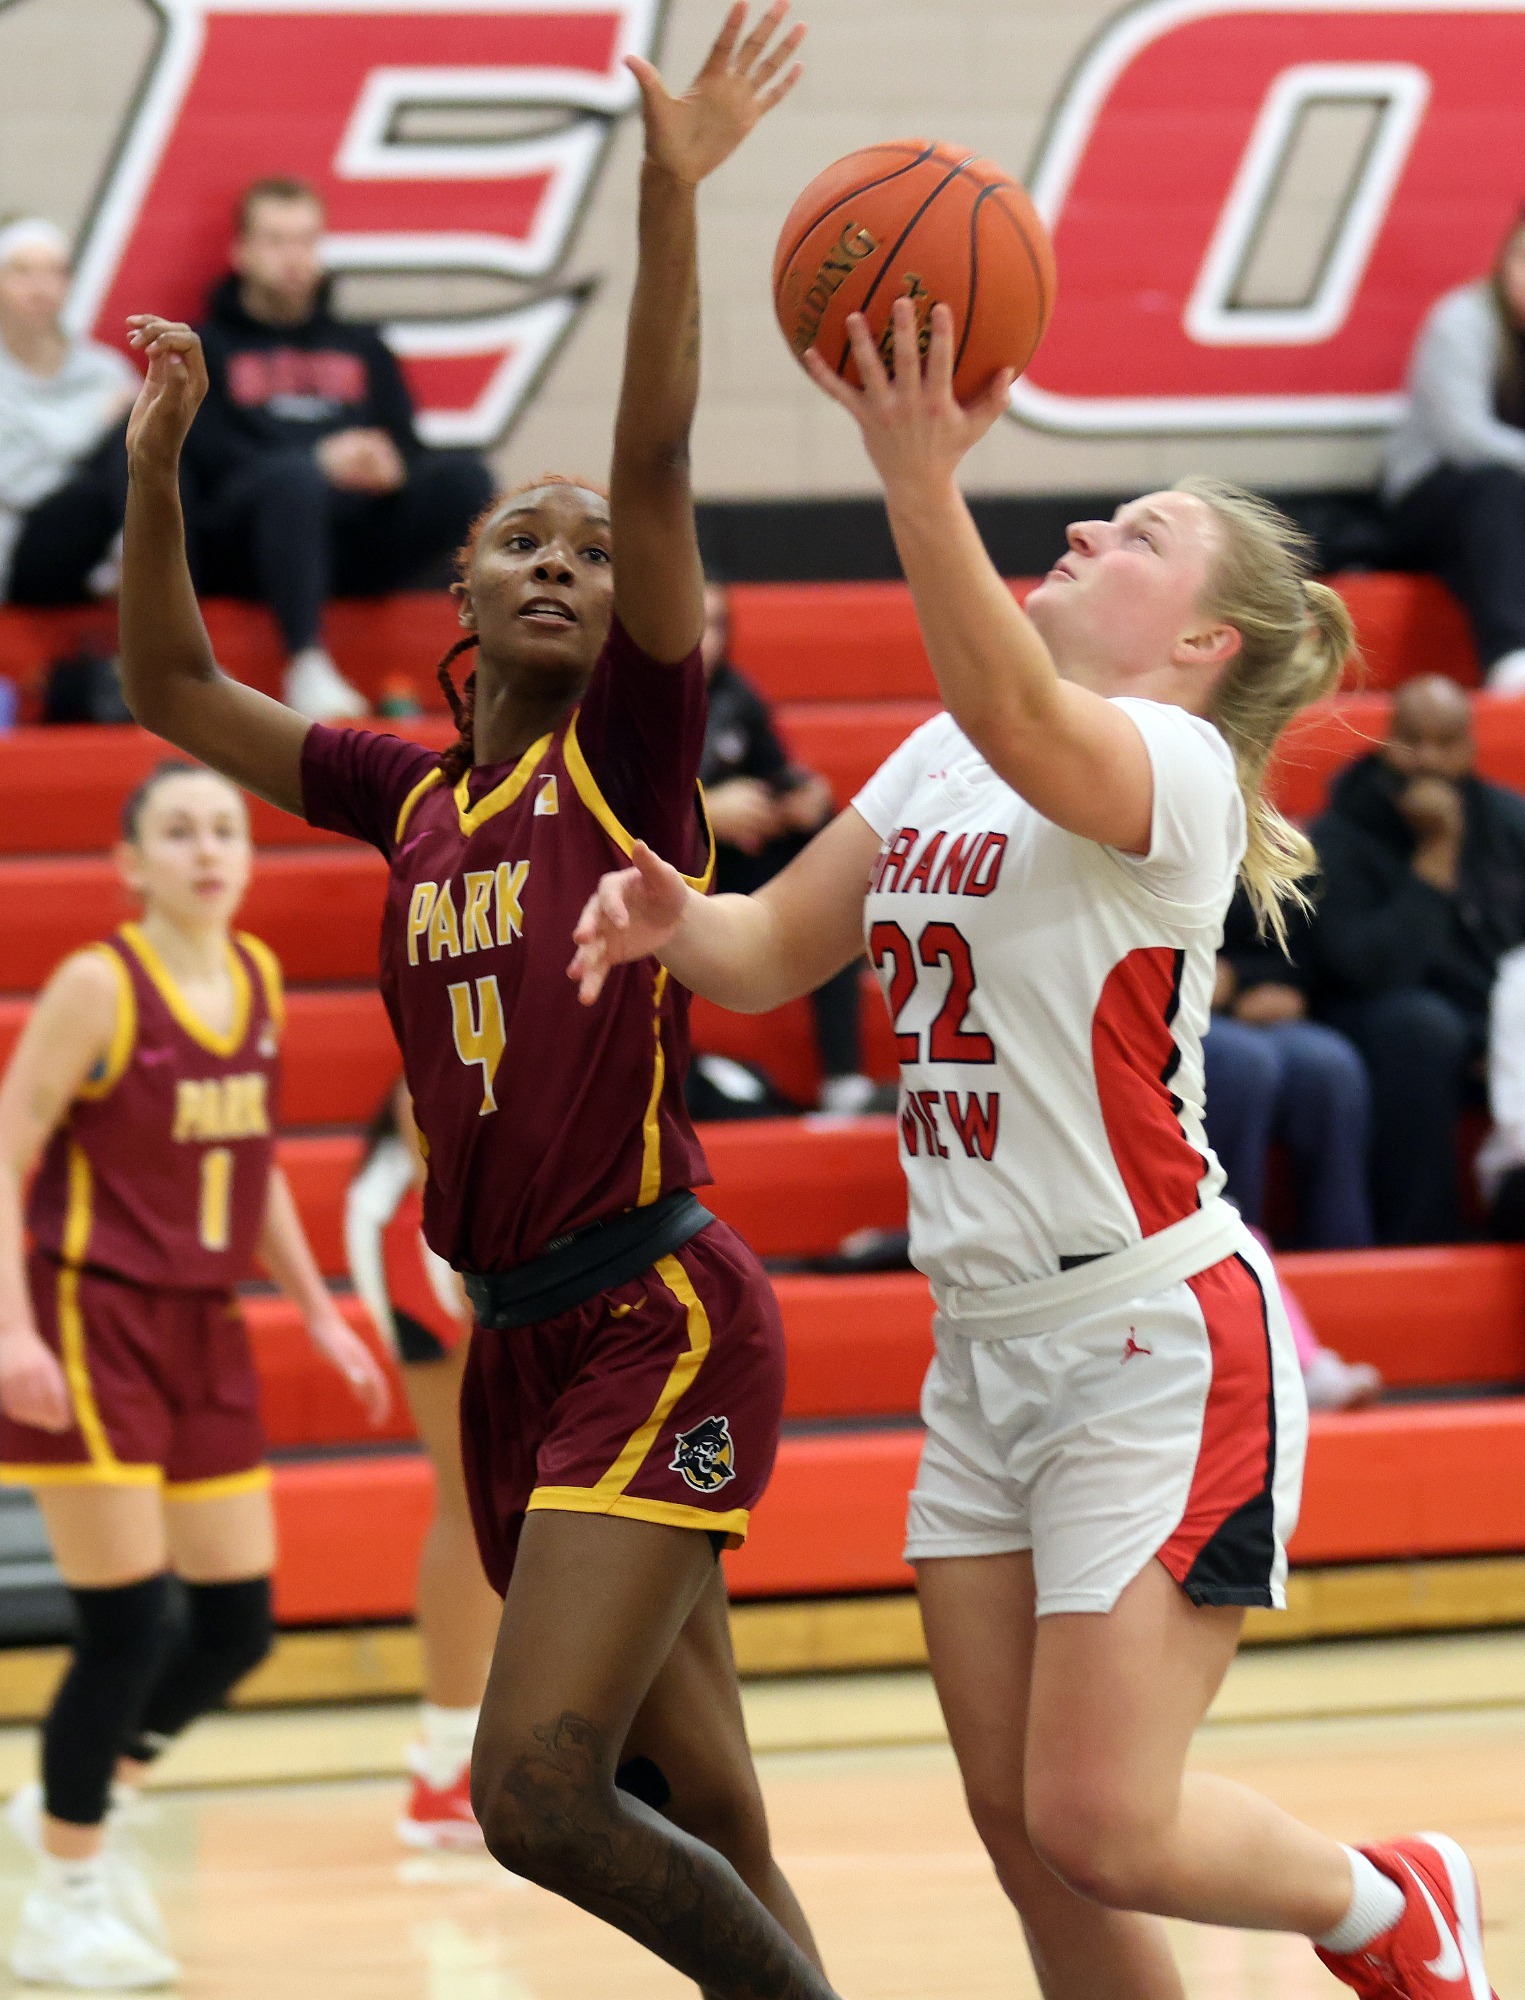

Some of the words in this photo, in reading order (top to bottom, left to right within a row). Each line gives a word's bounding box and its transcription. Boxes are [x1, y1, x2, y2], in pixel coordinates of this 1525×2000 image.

[789, 220, 881, 354] ALDING
[407, 860, 530, 966] PARK
[447, 975, 506, 1116] 4
[870, 920, 996, 1064] 22
[171, 1072, 271, 1144] PARK
[201, 1148, 234, 1252] 1
